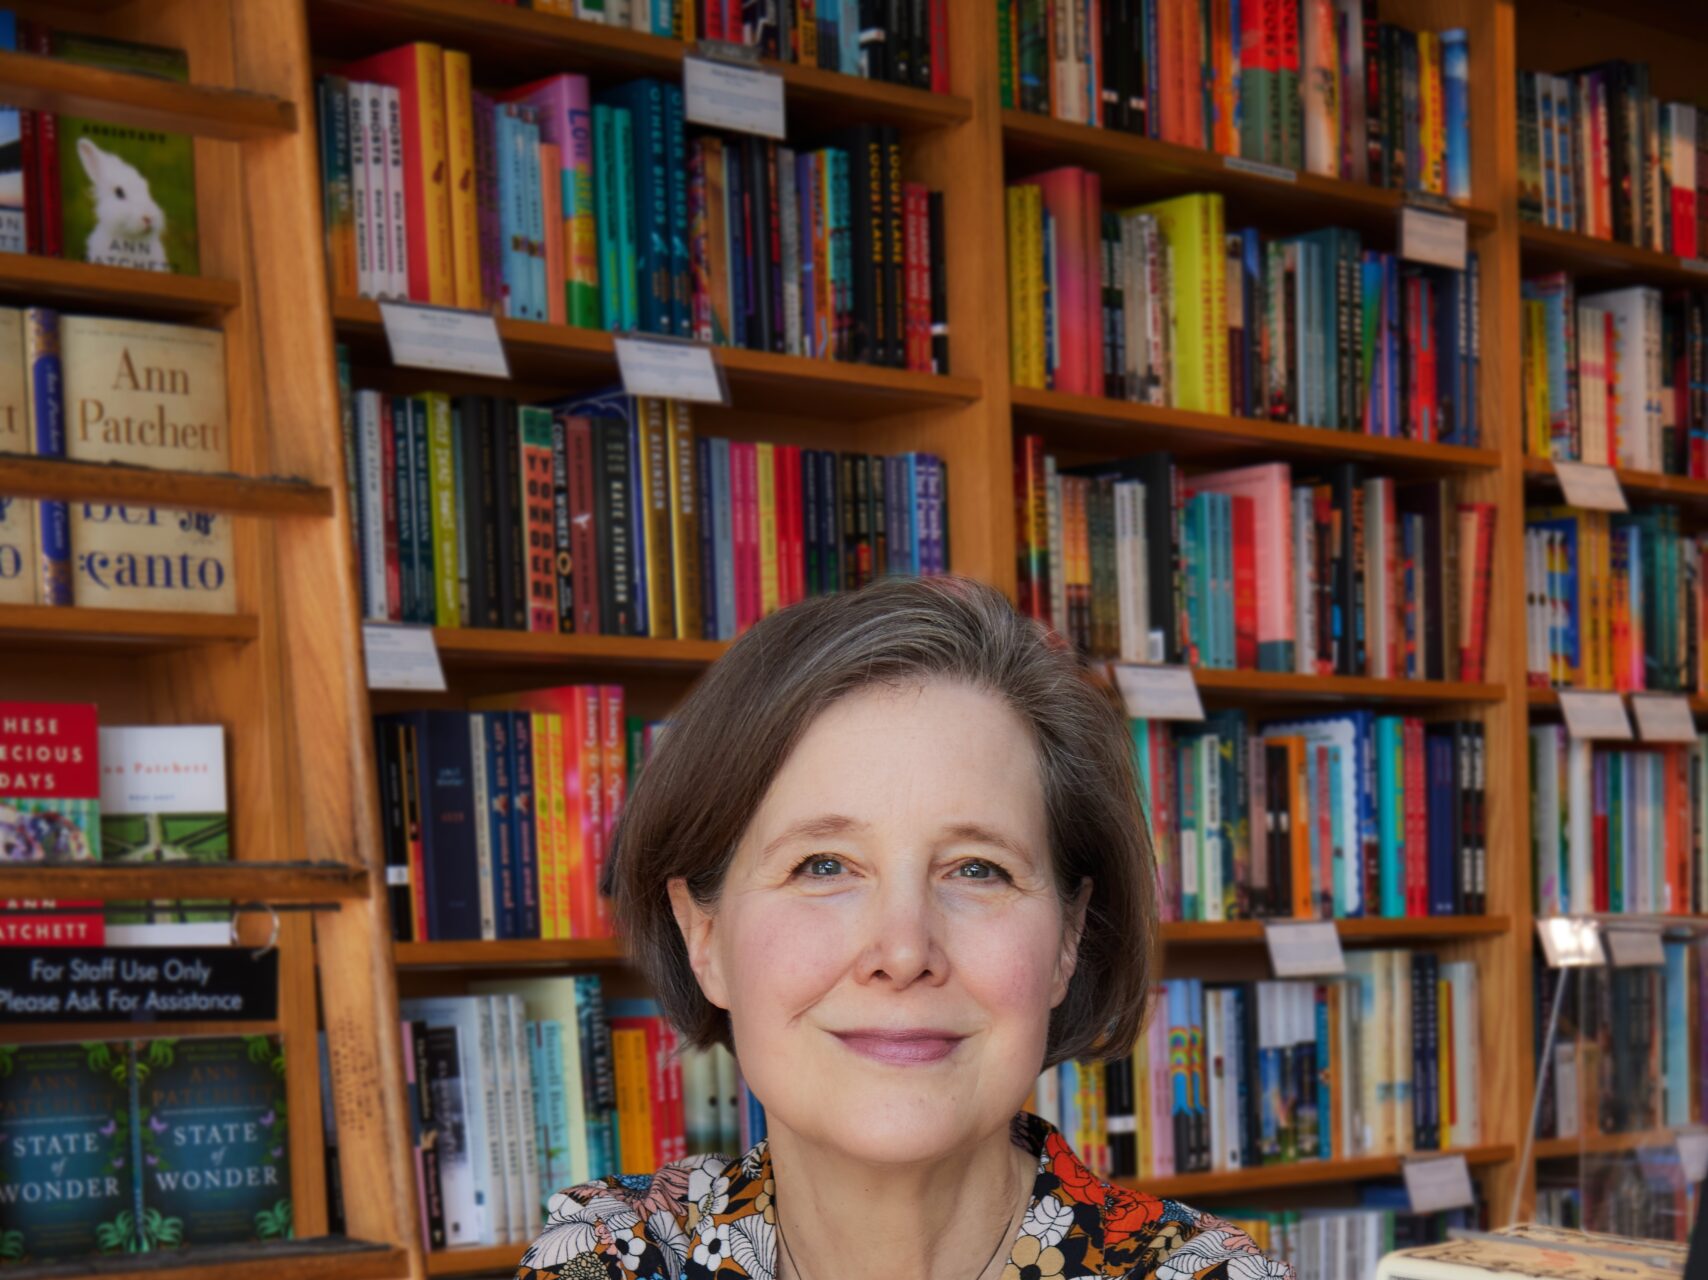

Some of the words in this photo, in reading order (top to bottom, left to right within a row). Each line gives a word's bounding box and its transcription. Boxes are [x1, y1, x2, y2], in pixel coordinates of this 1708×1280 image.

[1264, 0, 1278, 57] OOKS
[351, 98, 363, 164] GHOSTS
[370, 98, 382, 165] GHOSTS
[389, 100, 401, 167] GHOSTS
[869, 143, 881, 212] LOCUST
[889, 145, 901, 213] LOCUST
[110, 238, 151, 255] ANN
[873, 219, 883, 263] LANE
[891, 219, 902, 263] LANE
[111, 347, 191, 396] Ann
[79, 398, 222, 453] Patchett
[554, 423, 567, 487] CONJURE
[651, 434, 664, 510] ATKINSON
[679, 438, 693, 514] ATKINSON
[556, 493, 569, 548] WOMEN
[612, 481, 625, 518] KATE
[614, 526, 628, 603] ATKINSON
[4, 718, 58, 734] HESE
[0, 745, 83, 763] ECIOUS
[104, 765, 124, 775] nn
[0, 923, 87, 940] TCHETT
[31, 958, 64, 981] For
[70, 957, 116, 982] Staff
[121, 959, 158, 981] Use
[164, 958, 212, 985] Only
[65, 989, 101, 1011] Ask
[107, 988, 139, 1011] For
[145, 985, 243, 1012] Assistance
[13, 1132, 100, 1158] STATE
[173, 1122, 259, 1146] STATE
[210, 1146, 227, 1165] of
[51, 1157, 68, 1177] of
[156, 1165, 280, 1192] WONDER
